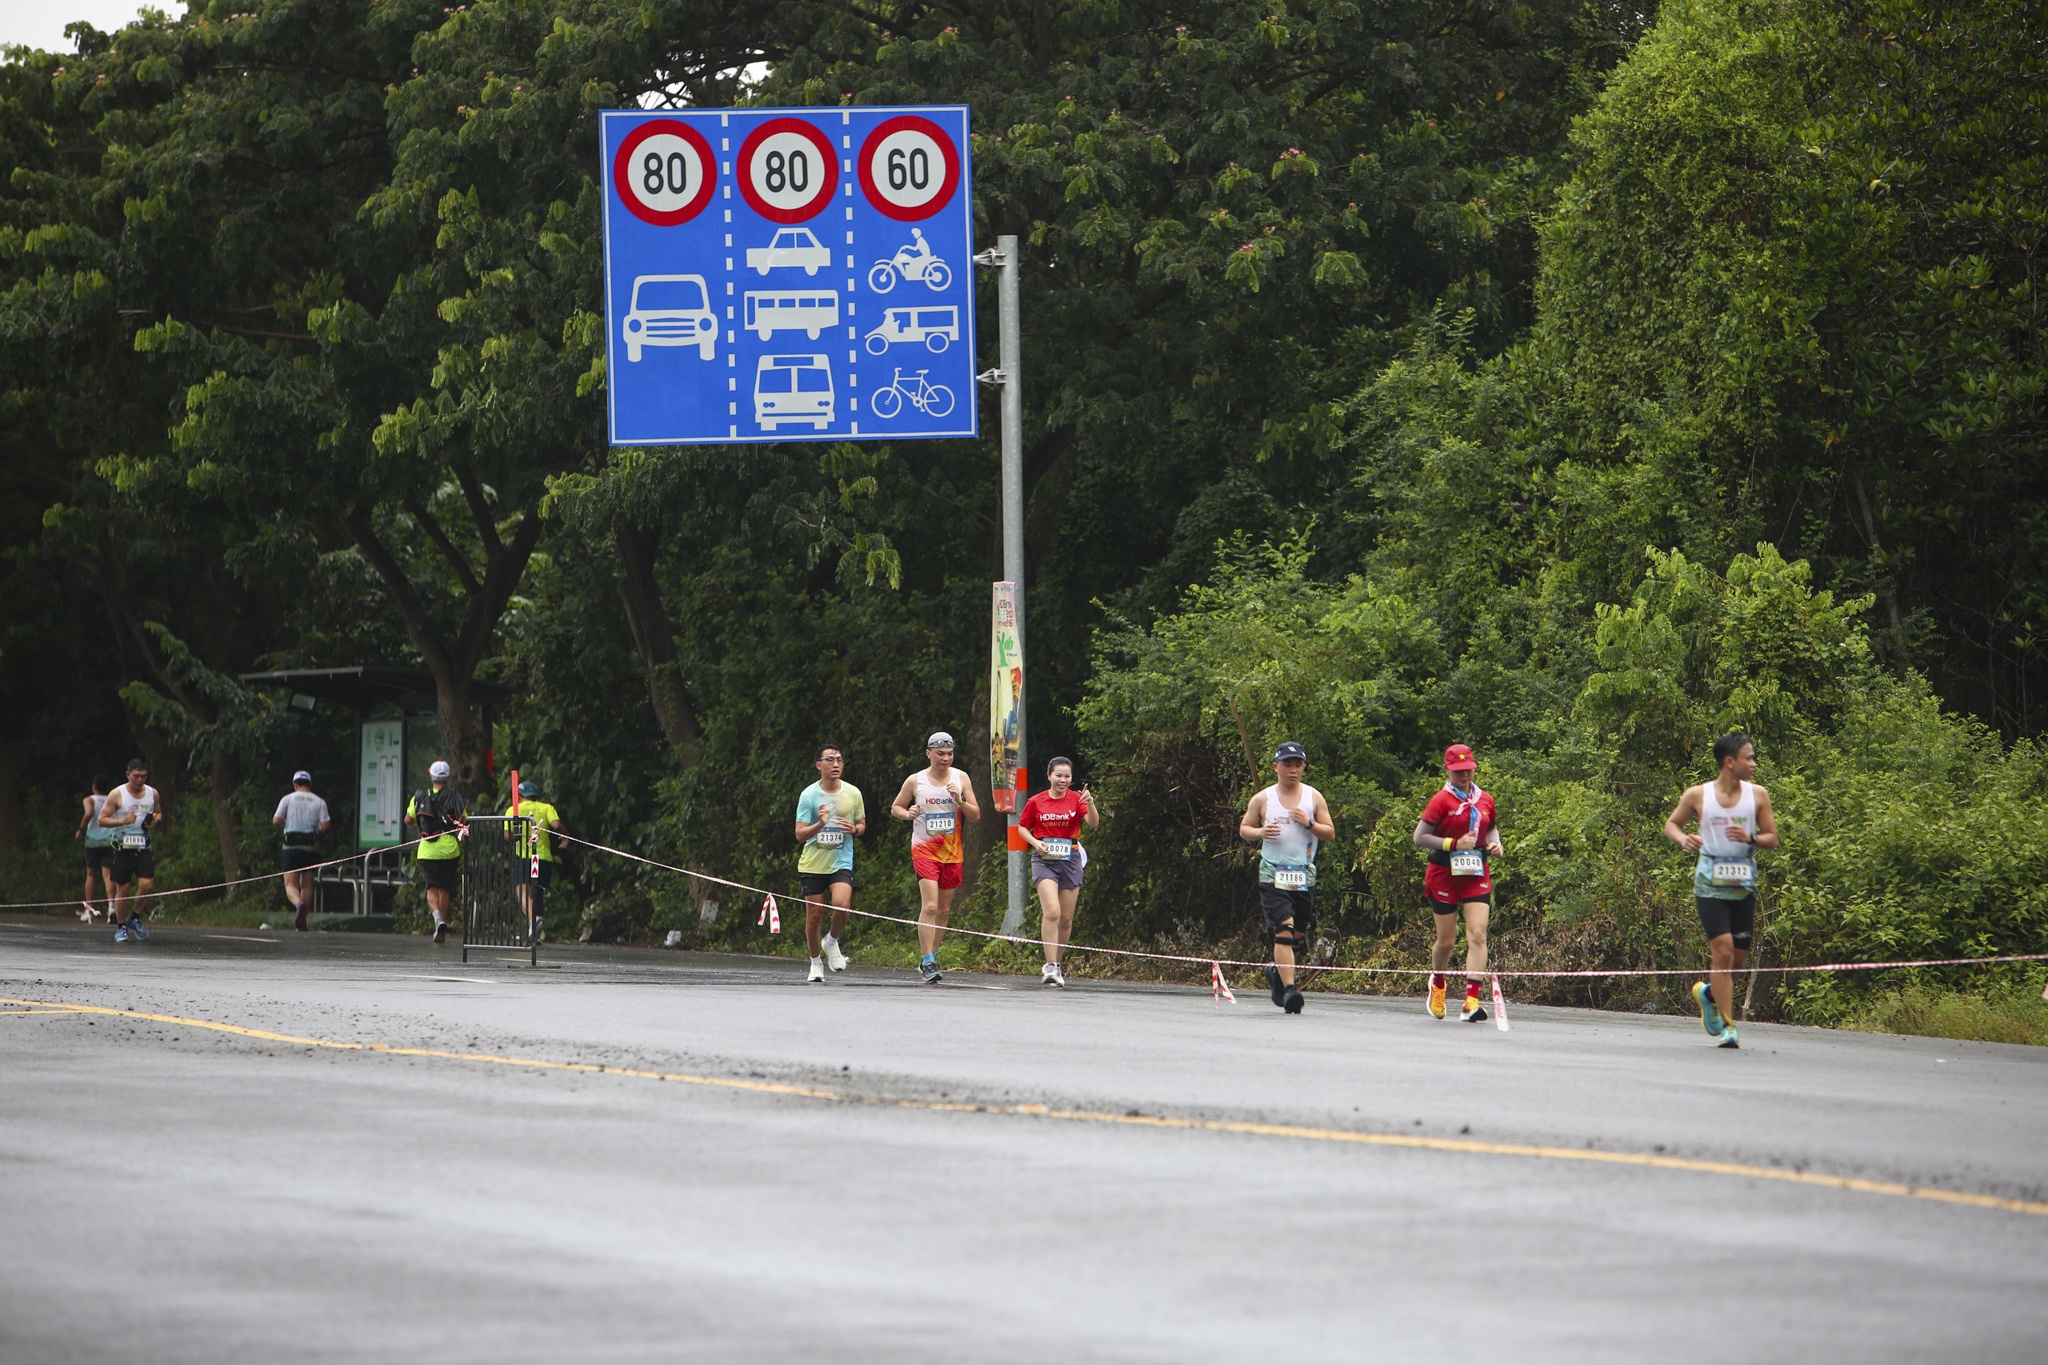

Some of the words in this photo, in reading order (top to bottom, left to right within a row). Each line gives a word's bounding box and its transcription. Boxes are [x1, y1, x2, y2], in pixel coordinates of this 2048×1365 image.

[643, 151, 687, 195] 80
[765, 150, 808, 193] 80
[887, 147, 929, 191] 60
[925, 797, 953, 805] HDBank
[1039, 813, 1070, 821] HDBank
[930, 819, 952, 828] 21210
[820, 833, 842, 842] 21374
[1454, 858, 1480, 867] 20040
[1718, 866, 1748, 876] 21312
[1279, 873, 1303, 882] 21186
